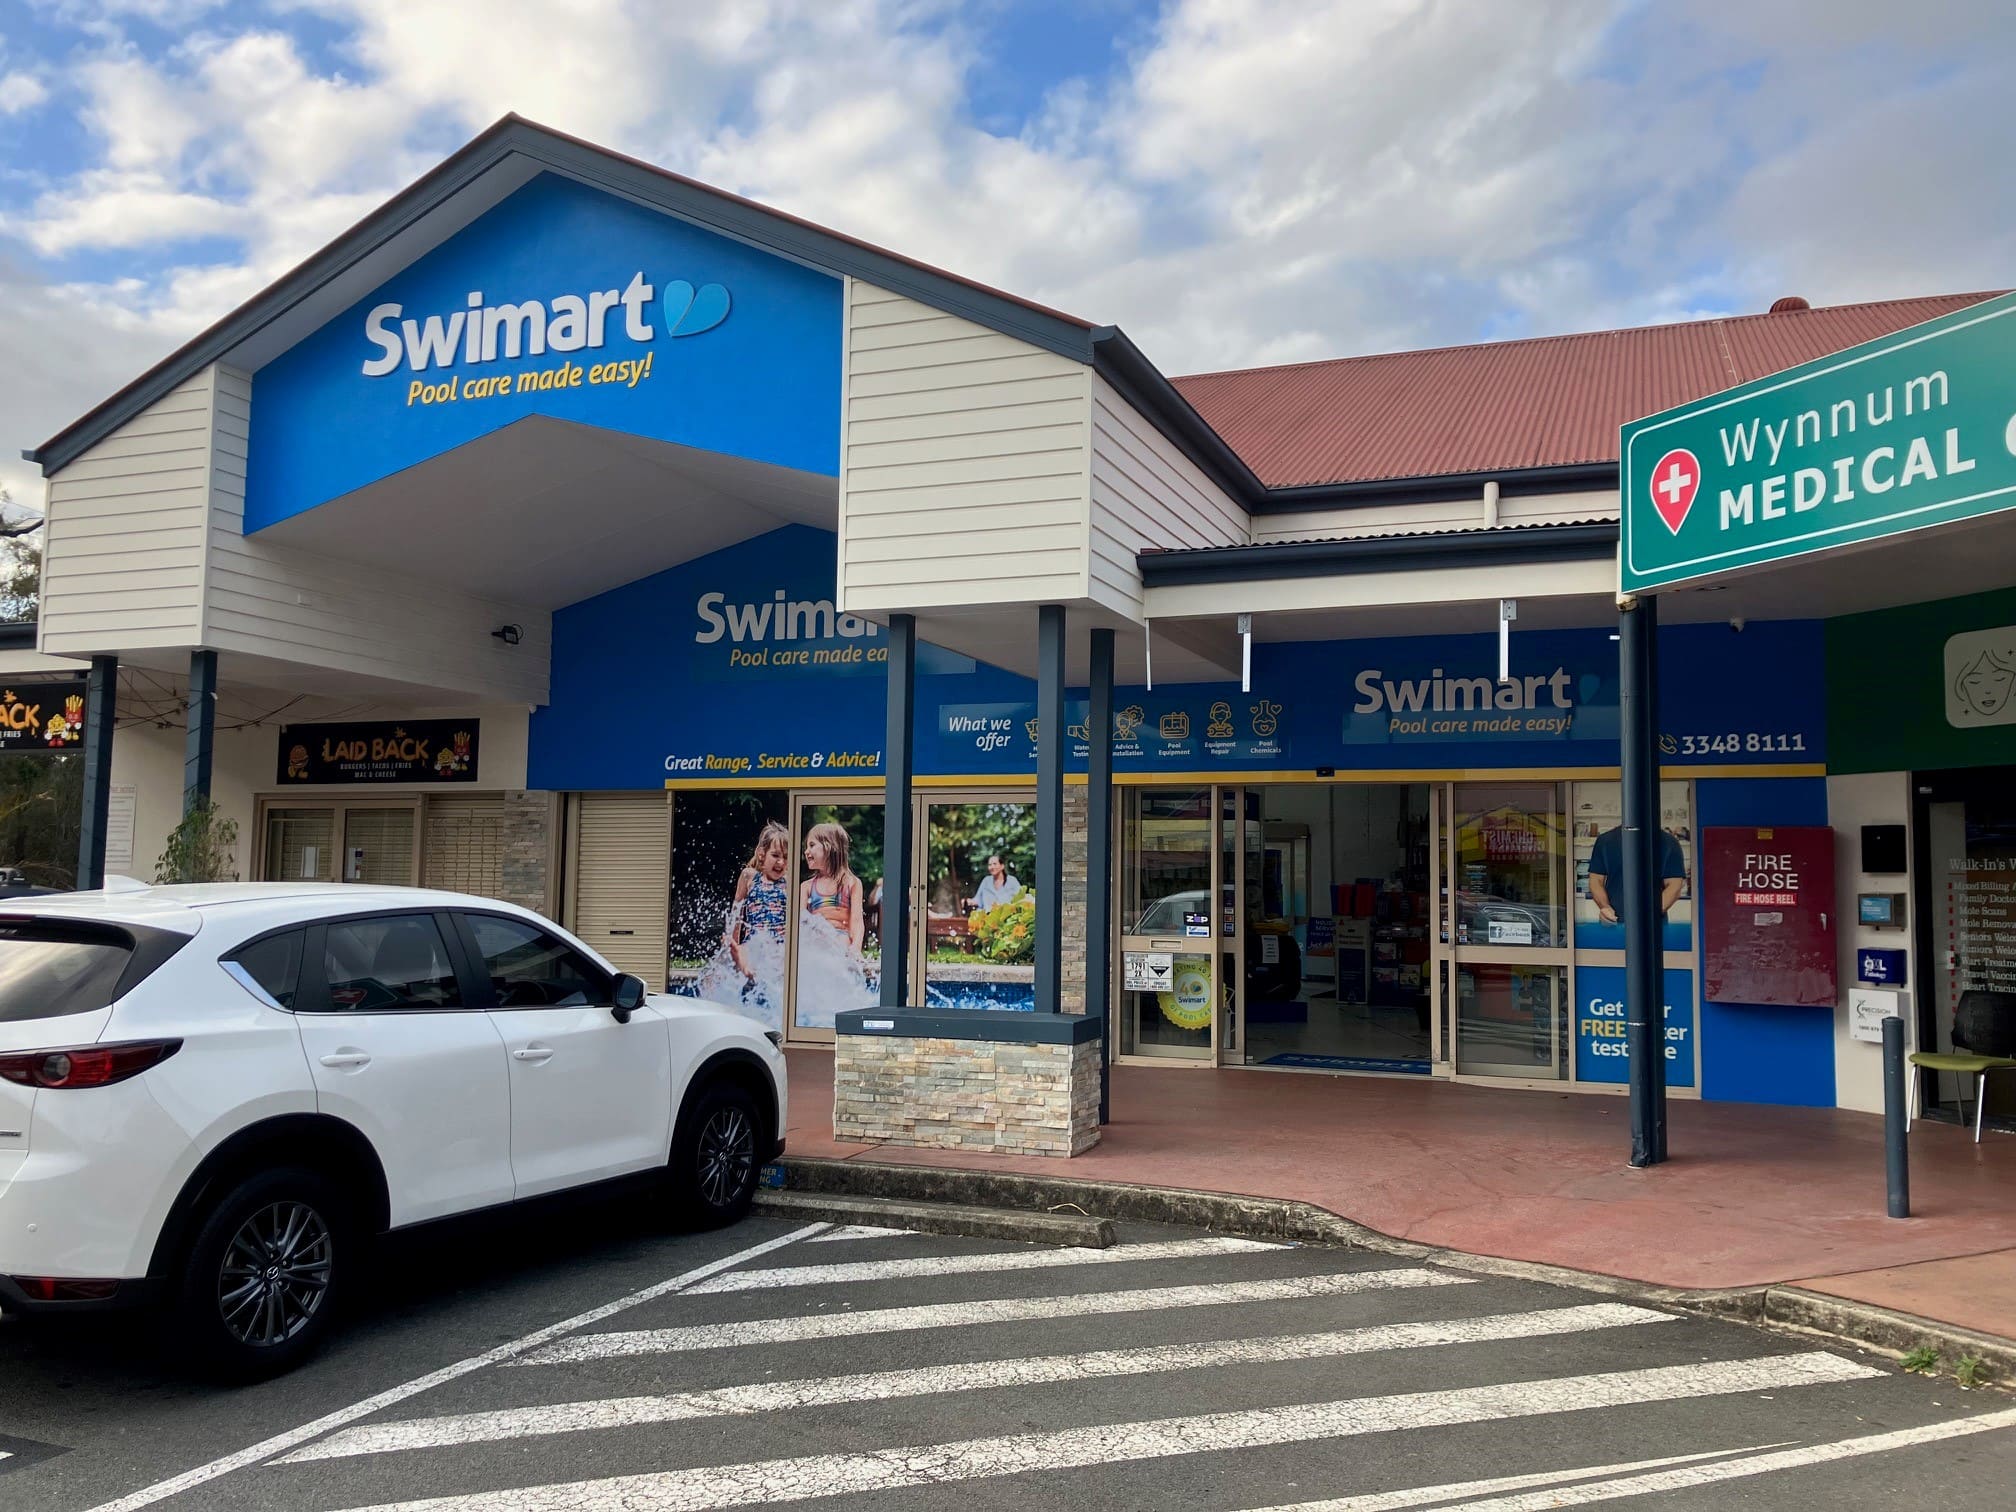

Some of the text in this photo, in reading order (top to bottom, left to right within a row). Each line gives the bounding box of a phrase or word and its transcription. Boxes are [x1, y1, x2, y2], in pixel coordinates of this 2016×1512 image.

[362, 271, 654, 377] Swimart
[407, 351, 654, 406] Pool care made easy!
[1719, 370, 1949, 467] Wynnum
[1719, 427, 1976, 531] MEDICAL
[730, 648, 768, 667] Pool
[772, 650, 810, 665] care
[813, 645, 862, 664] made
[1353, 666, 1573, 714] Swimart
[948, 717, 1012, 732] What we
[1389, 714, 1572, 735] Pool care made easy!
[322, 737, 429, 762] LAID BACK
[976, 732, 1011, 751] offer
[1204, 740, 1236, 749] Equipment
[1681, 732, 1806, 755] 3348 8111
[1158, 749, 1190, 757] Equipment
[664, 751, 881, 774] Great Range, Service & Advice!
[1745, 854, 1793, 870] FIRE
[1949, 858, 2006, 872] Walk-In's
[1738, 872, 1799, 889] HOSE
[1735, 893, 1796, 905] FIRE HOSE REEL
[1990, 894, 2016, 903] Docto
[1960, 906, 1980, 915] Mole
[1960, 918, 2016, 929] Mole Remova
[1962, 981, 2016, 993] Heart Tracin
[1178, 996, 1207, 1004] Swimart
[1589, 998, 1625, 1016] Get
[1861, 1006, 1891, 1014] PRECISION
[1581, 1020, 1627, 1038] FREE
[1592, 1040, 1630, 1057] test
